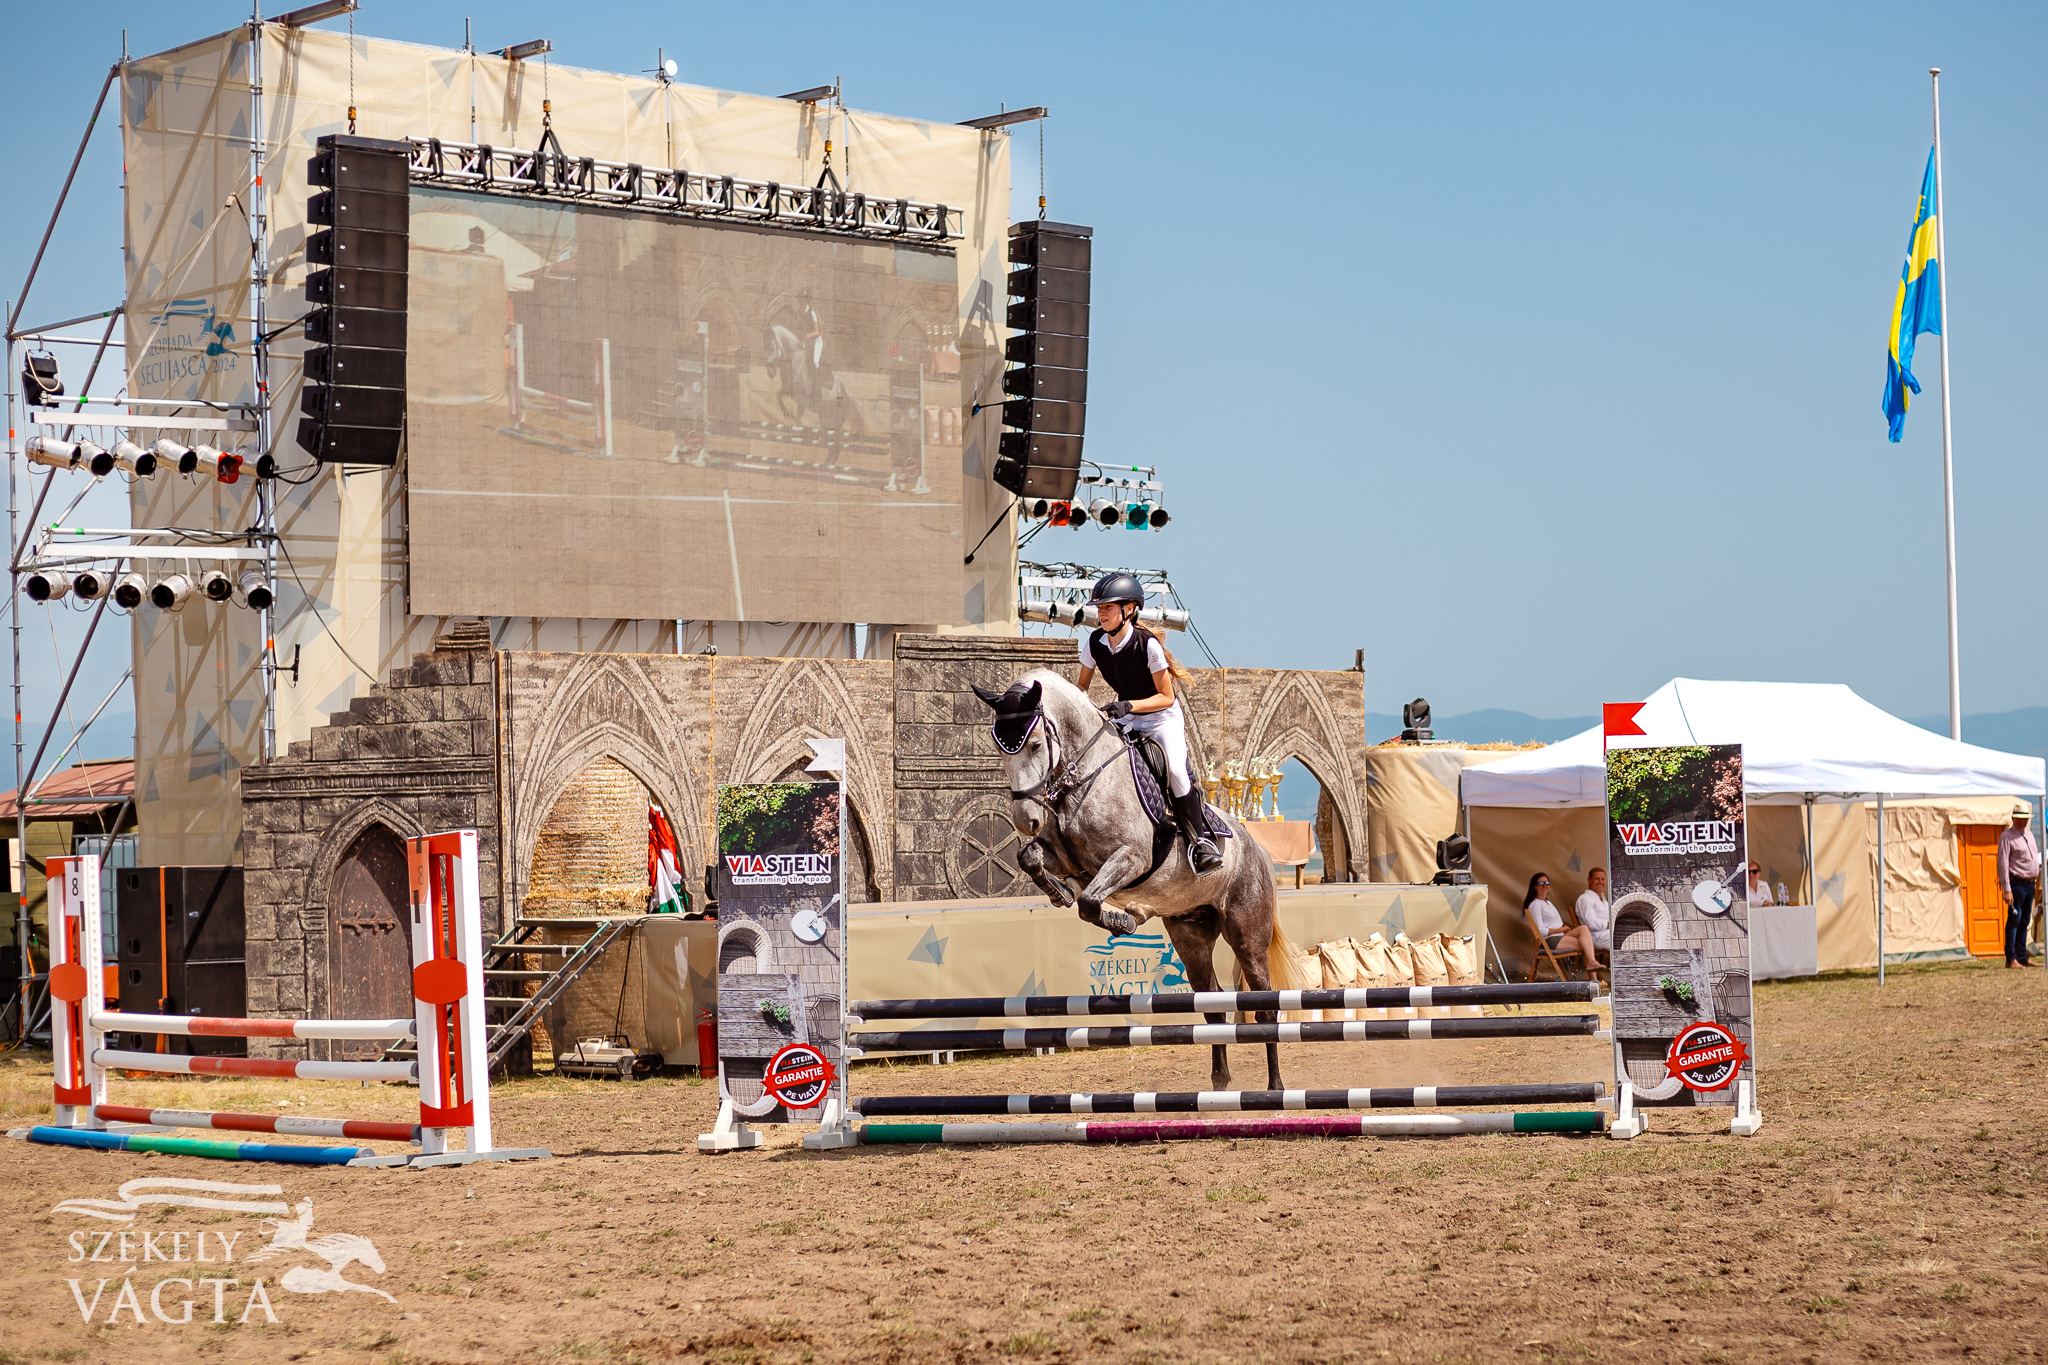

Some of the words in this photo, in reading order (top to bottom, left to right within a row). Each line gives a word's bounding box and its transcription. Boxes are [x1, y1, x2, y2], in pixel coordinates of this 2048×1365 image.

[213, 357, 236, 373] 2024
[1617, 821, 1735, 844] VIASTEIN
[1627, 844, 1686, 854] transforming
[1689, 842, 1705, 851] the
[1708, 843, 1735, 853] space
[726, 854, 831, 874] VIASTEIN
[418, 865, 424, 885] 8
[734, 875, 787, 884] transforming
[789, 874, 803, 883] the
[806, 876, 831, 884] space
[72, 877, 79, 896] 8
[1089, 956, 1150, 977] SZÉKELY
[1684, 1034, 1721, 1047] VIASTEIN
[780, 1055, 813, 1067] VIASTEIN
[1692, 1072, 1704, 1082] PE
[786, 1090, 797, 1100] PE
